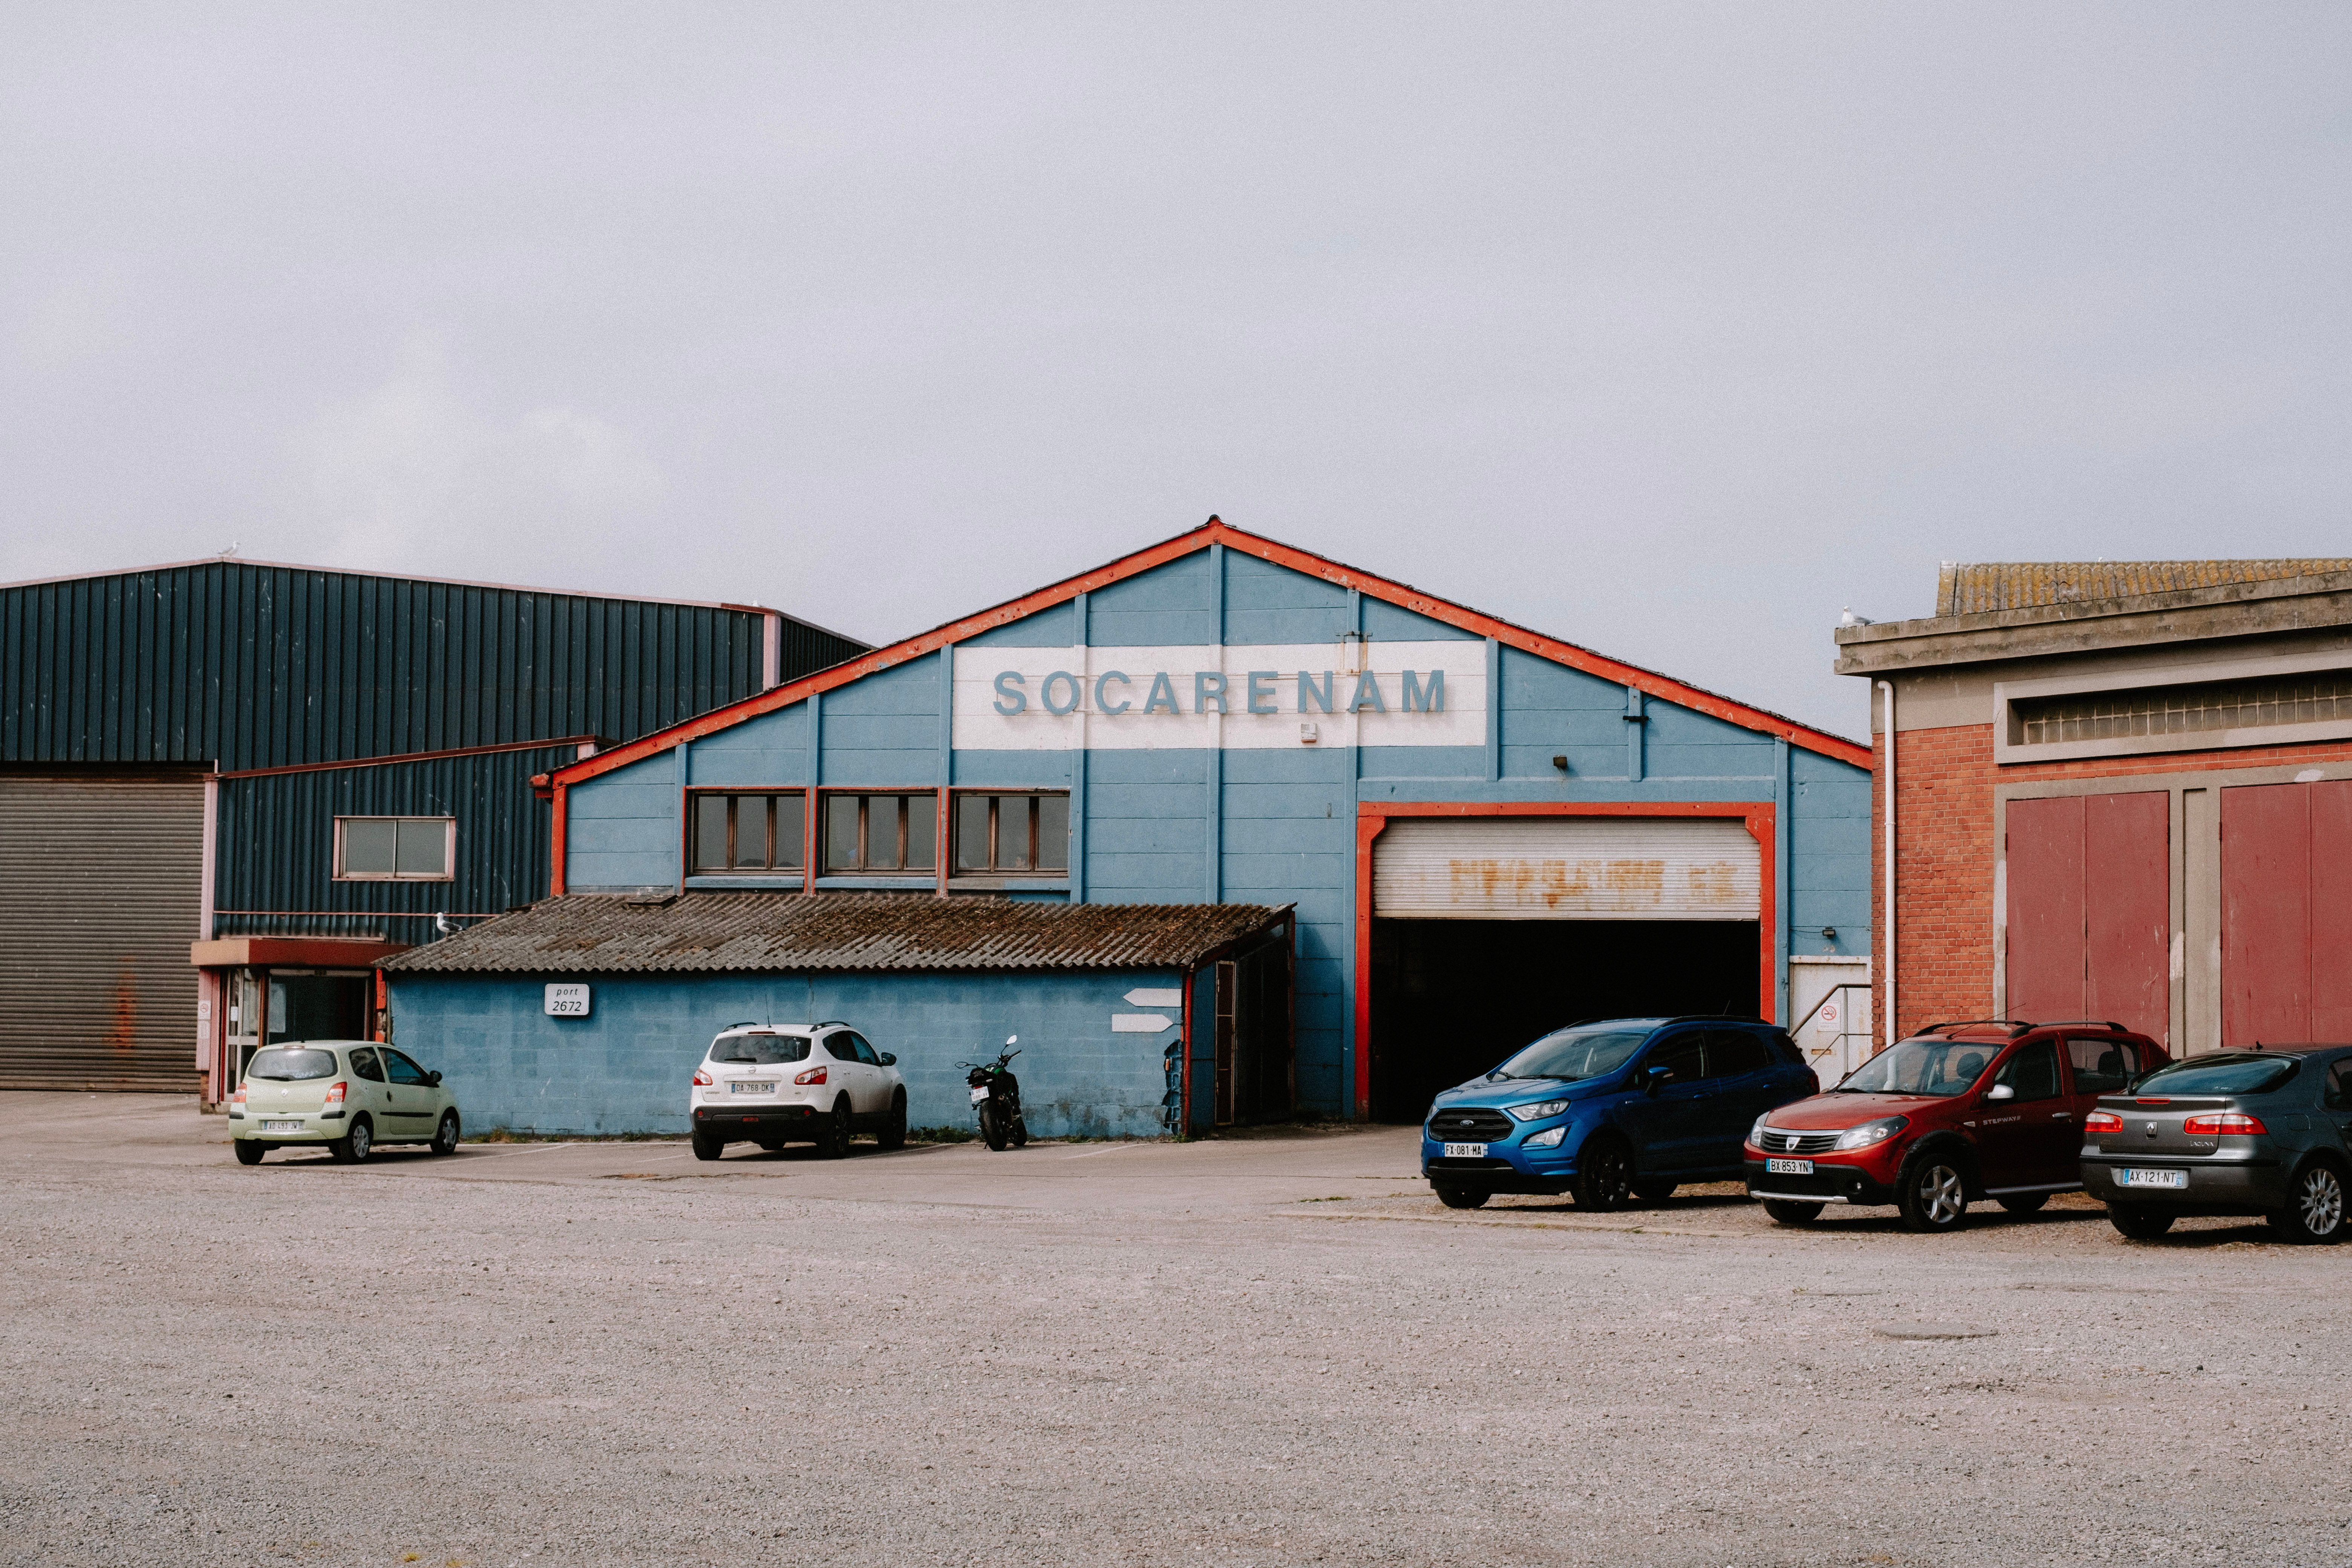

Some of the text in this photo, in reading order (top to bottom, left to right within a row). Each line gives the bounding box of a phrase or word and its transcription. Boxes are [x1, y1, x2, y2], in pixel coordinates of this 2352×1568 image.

[993, 670, 1444, 715] SOCARENAM
[556, 988, 578, 997] port
[553, 1001, 581, 1011] 2672
[1983, 1116, 2016, 1125] STEPWAY
